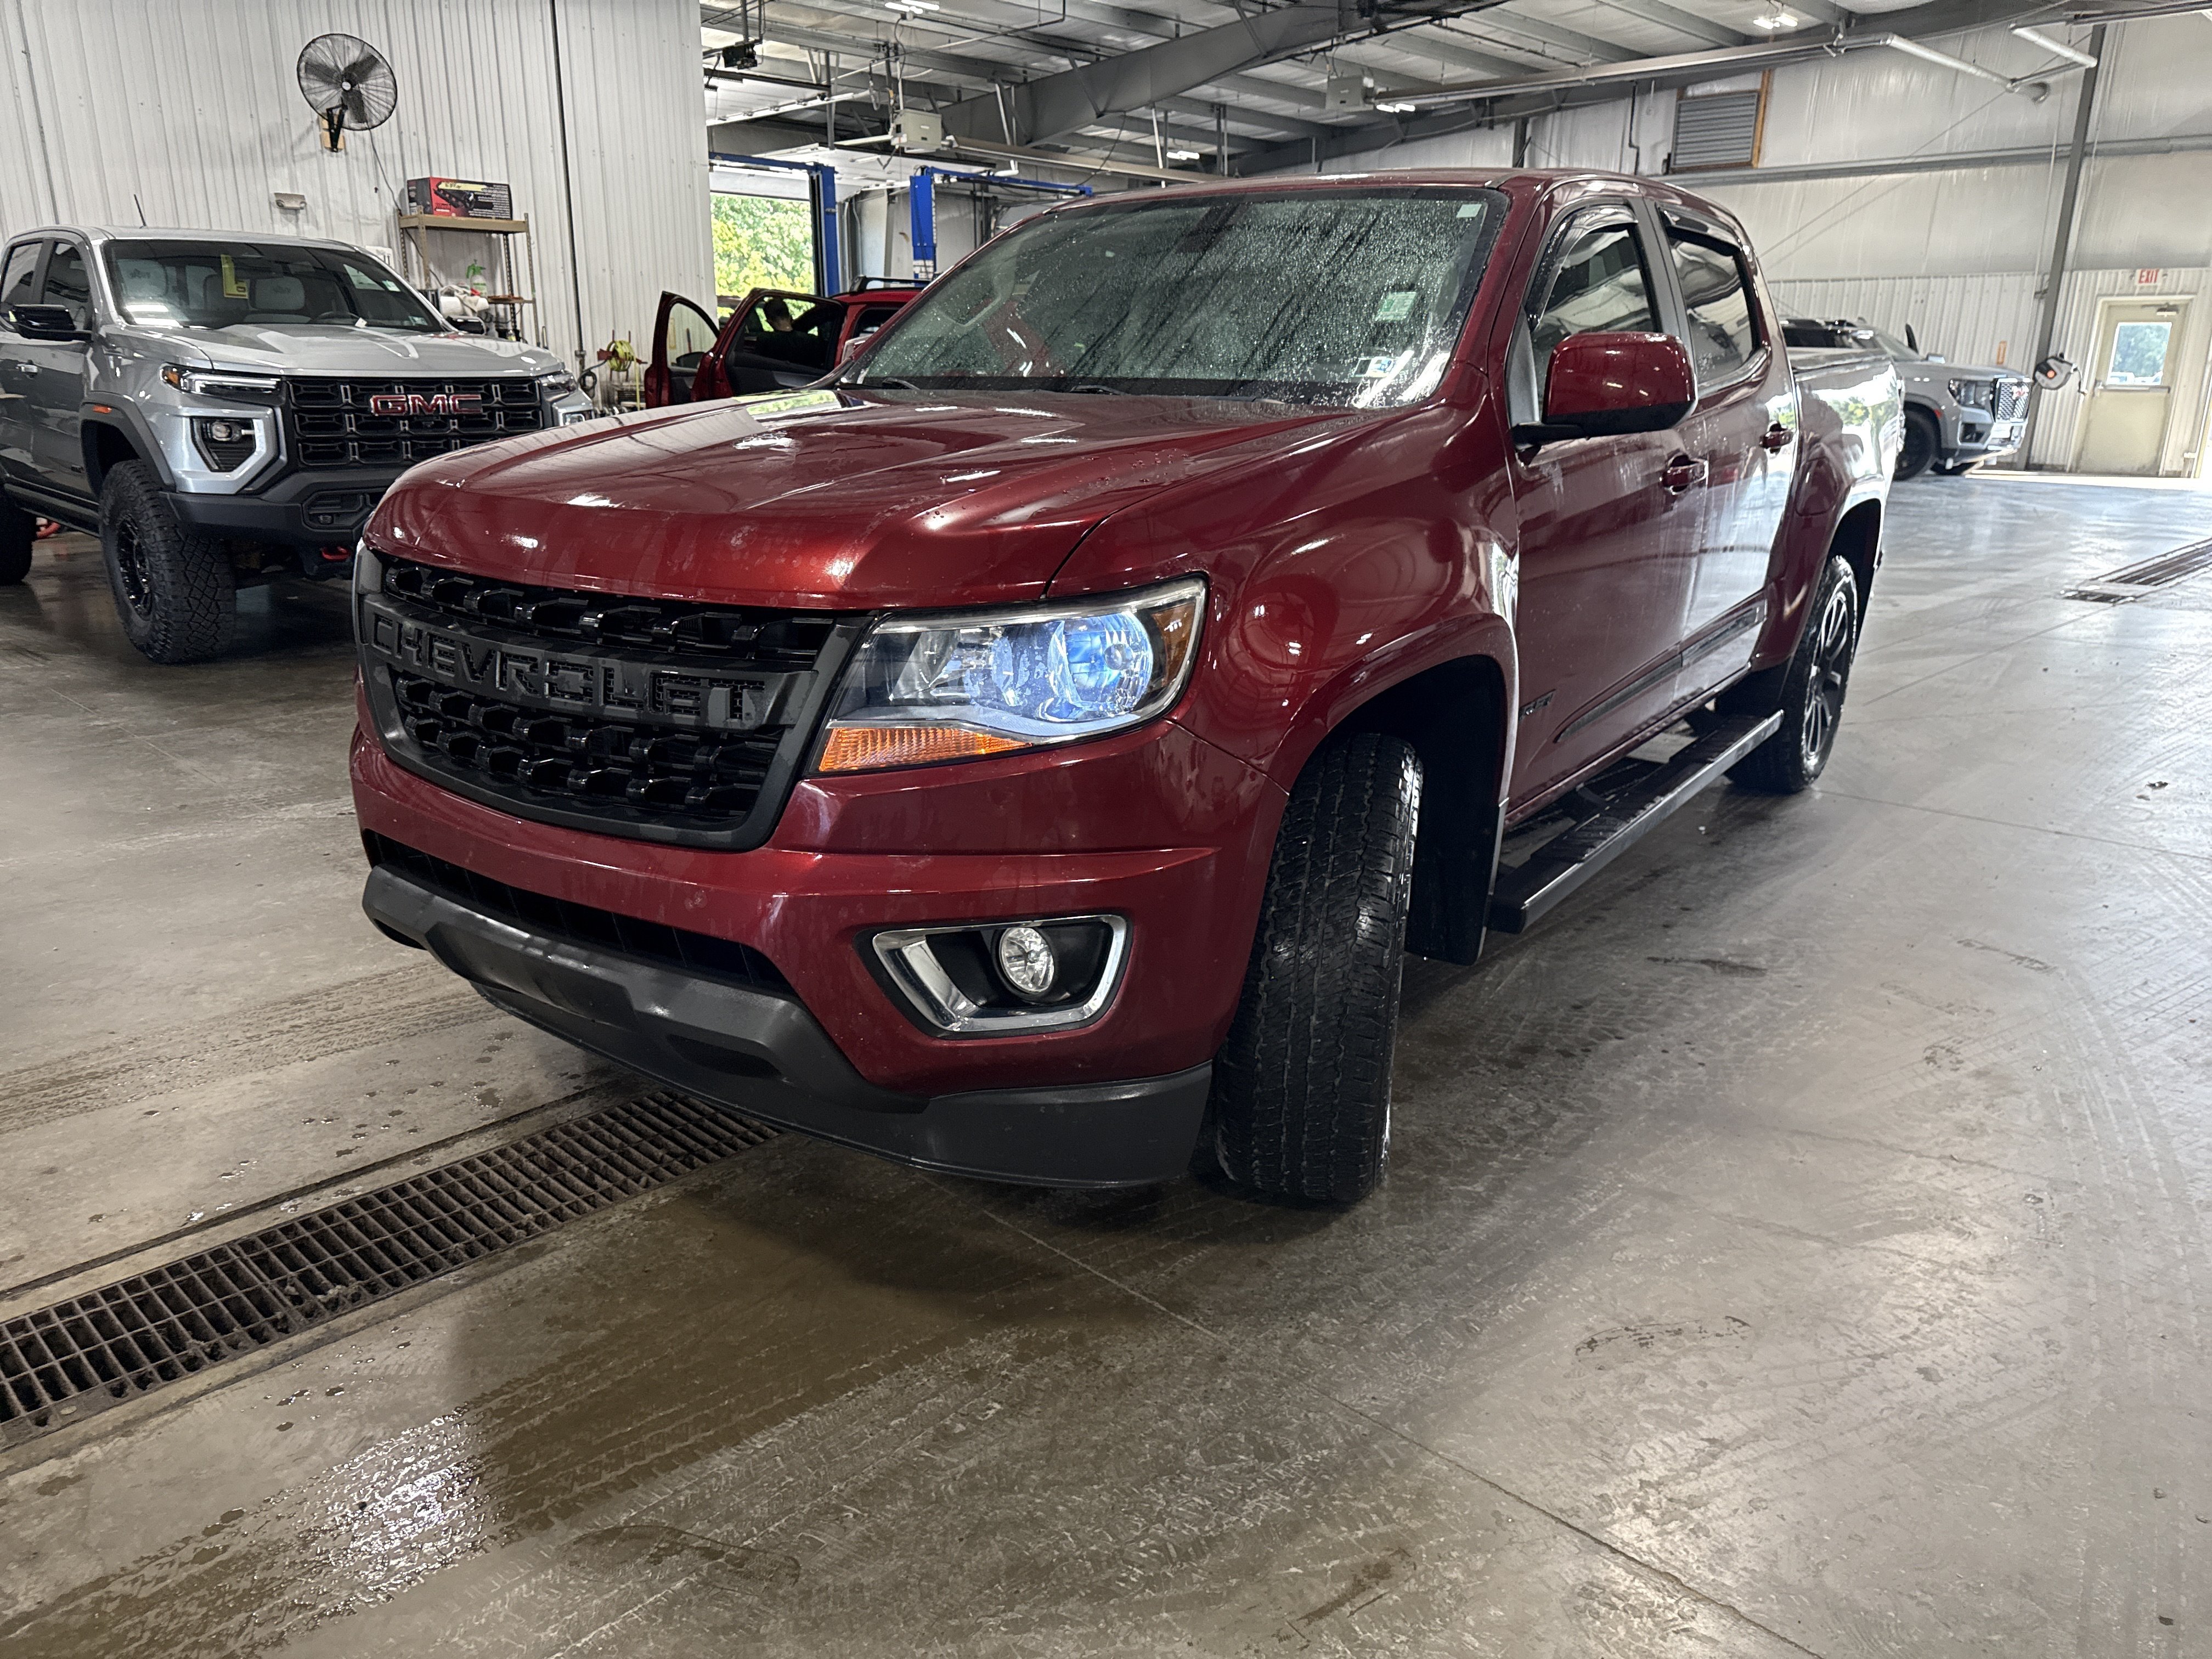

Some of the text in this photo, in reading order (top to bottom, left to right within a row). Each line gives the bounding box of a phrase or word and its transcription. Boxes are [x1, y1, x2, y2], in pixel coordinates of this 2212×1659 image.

[2138, 268, 2160, 284] EXIT
[370, 394, 483, 416] GMC
[371, 612, 766, 723] CHEVROLET
